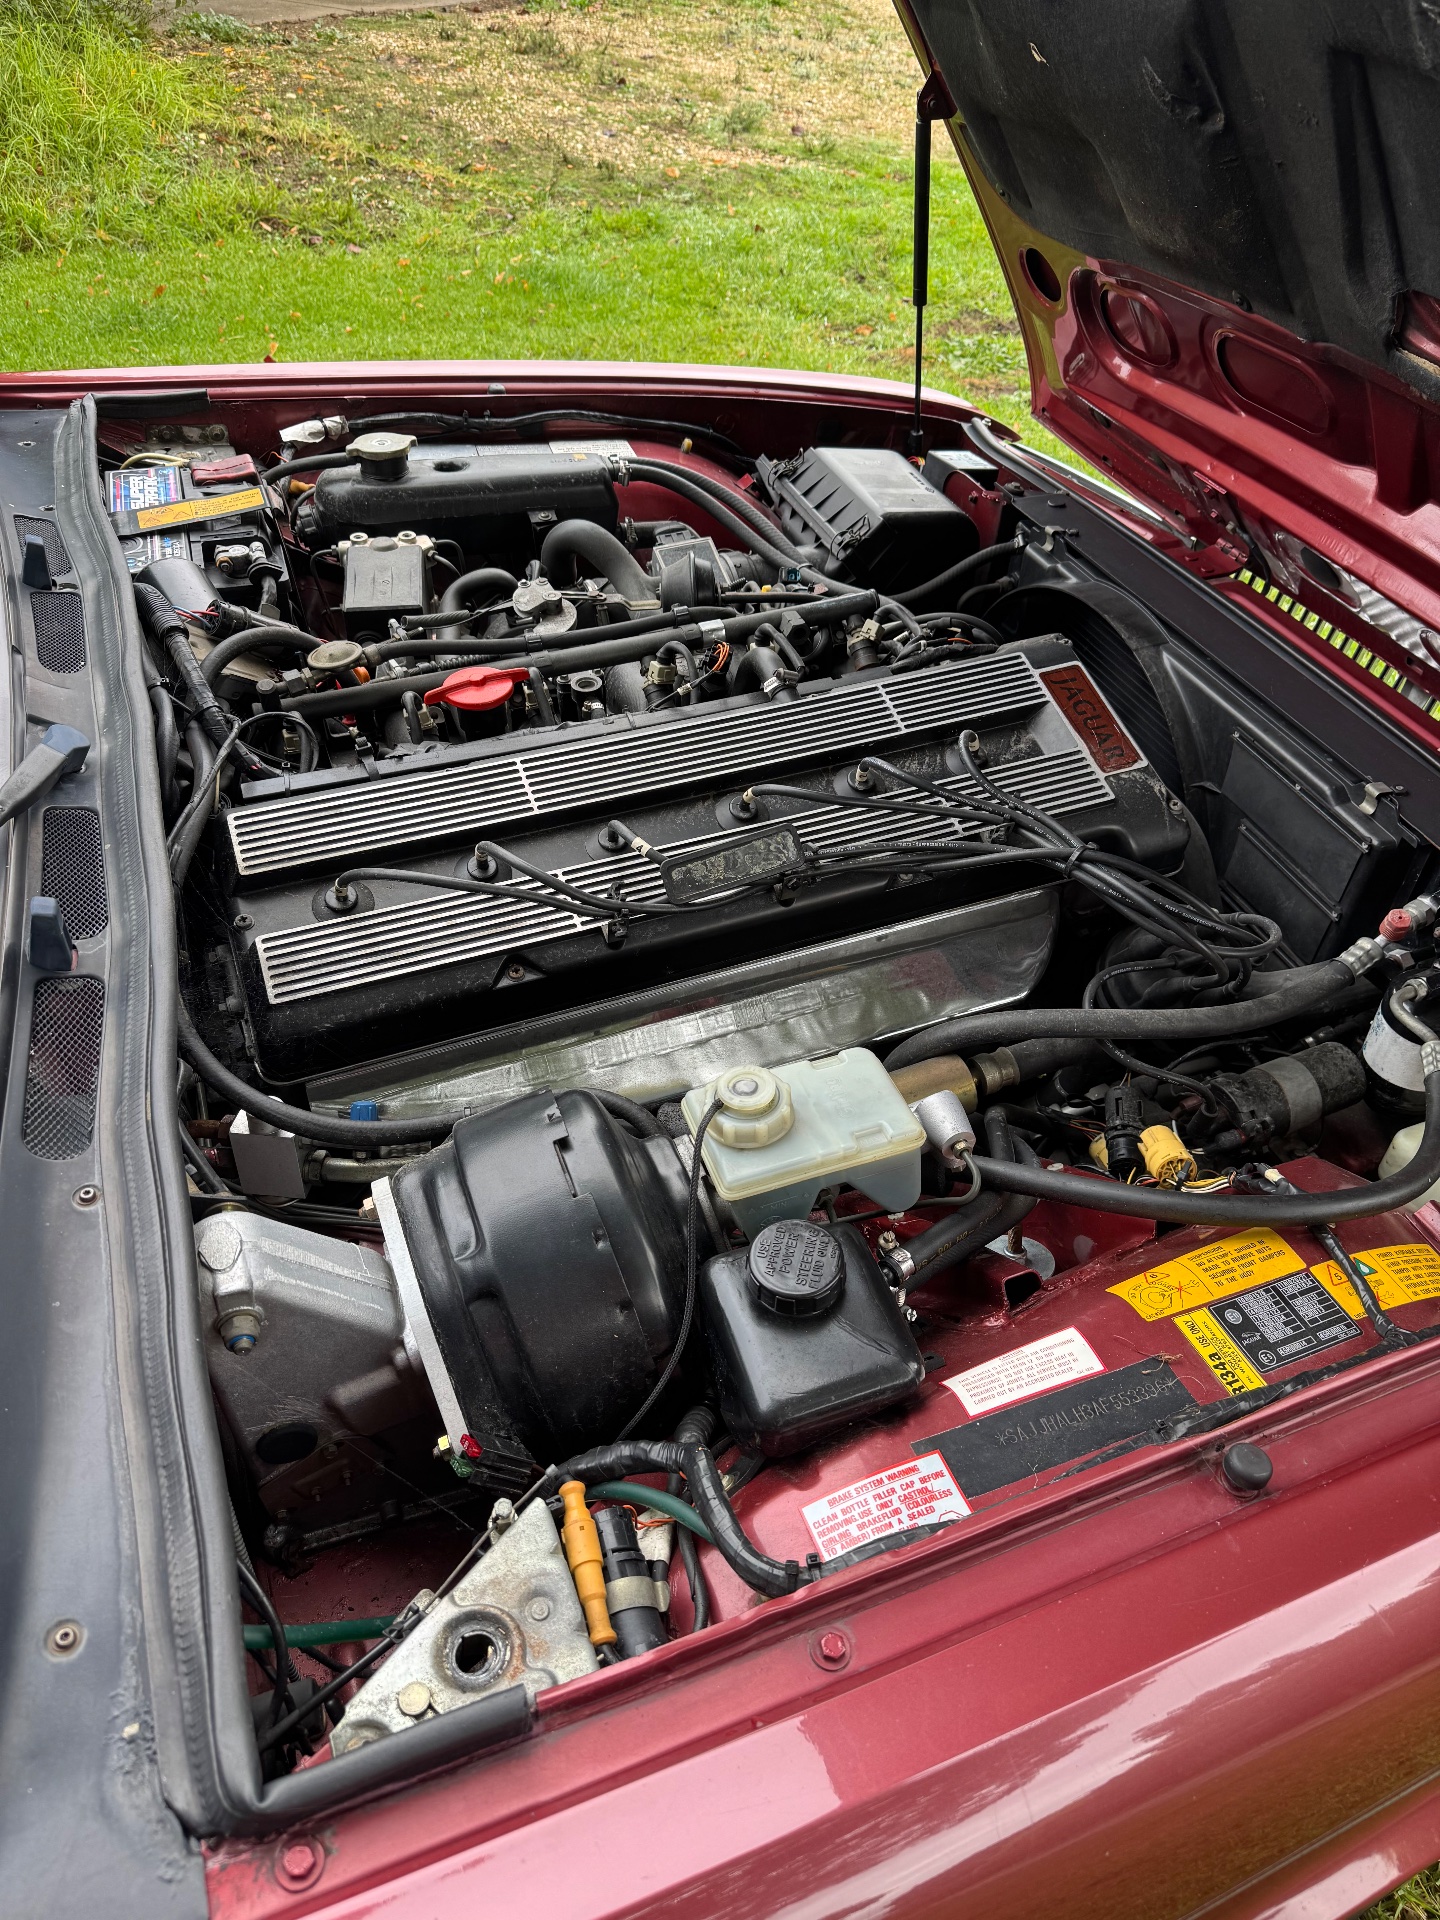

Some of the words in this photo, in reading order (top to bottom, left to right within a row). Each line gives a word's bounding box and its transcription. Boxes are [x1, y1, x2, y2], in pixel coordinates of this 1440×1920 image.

[130, 476, 144, 509] SUPER
[1049, 677, 1125, 760] JAGUAR
[757, 1239, 771, 1258] USE
[764, 1226, 786, 1277] APPROVED
[779, 1233, 799, 1273] POWER
[796, 1229, 819, 1286] STEERING
[808, 1260, 825, 1289] FLUID
[817, 1231, 830, 1257] ONLY
[1202, 1263, 1220, 1273] MADE
[1221, 1259, 1231, 1267] TO
[1231, 1250, 1255, 1263] REMOVE
[1255, 1244, 1272, 1255] NUTS
[1206, 1250, 1232, 1264] ATTEMPT
[1233, 1241, 1256, 1253] SHOULD
[1208, 1265, 1237, 1280] SECURING
[1237, 1259, 1256, 1270] FRONT
[1259, 1249, 1285, 1263] DAMPERS
[1214, 1279, 1224, 1287] TO
[1226, 1274, 1238, 1283] THE
[1239, 1268, 1255, 1279] BODY
[1333, 1273, 1343, 1281] 5
[1182, 1319, 1200, 1335] ONLY
[1194, 1333, 1210, 1350] USE
[1012, 1368, 1024, 1376] NOT
[1024, 1364, 1034, 1372] USE
[1034, 1357, 1054, 1368] EXCESS
[1053, 1353, 1067, 1362] HEAT
[1015, 1354, 1029, 1362] WITH
[1039, 1337, 1075, 1353] CONDITIONING
[961, 1372, 995, 1388] PRESSURISED
[995, 1367, 1009, 1375] WITH
[969, 1384, 997, 1399] PROXIMITY
[1026, 1371, 1036, 1379] ALL
[1036, 1364, 1057, 1375] SERVICE
[1056, 1359, 1072, 1368] MUST
[973, 1392, 996, 1405] CARRIED
[995, 1388, 1007, 1397] OUT
[1007, 1385, 1015, 1393] BY
[1023, 1371, 1055, 1387] ACCREDITED
[813, 1512, 838, 1530] CLEAN
[841, 1498, 870, 1516] BOTTLE
[872, 1487, 897, 1502] FILLER
[900, 1480, 915, 1491] CAP
[919, 1470, 946, 1485] BEFORE
[827, 1491, 854, 1507] BRAKE
[854, 1477, 885, 1495] SYSTEM
[885, 1464, 920, 1481] WARNING
[821, 1531, 852, 1549] GIRLING
[856, 1507, 903, 1532] BRAKEFLUID
[905, 1489, 953, 1511] (COLOURLESS
[876, 1500, 894, 1511] ONLY
[825, 1548, 838, 1558] TO
[840, 1530, 871, 1550] AMBER)
[871, 1522, 894, 1537] FROM
[897, 1517, 904, 1526] A
[907, 1505, 936, 1521] SEALED
